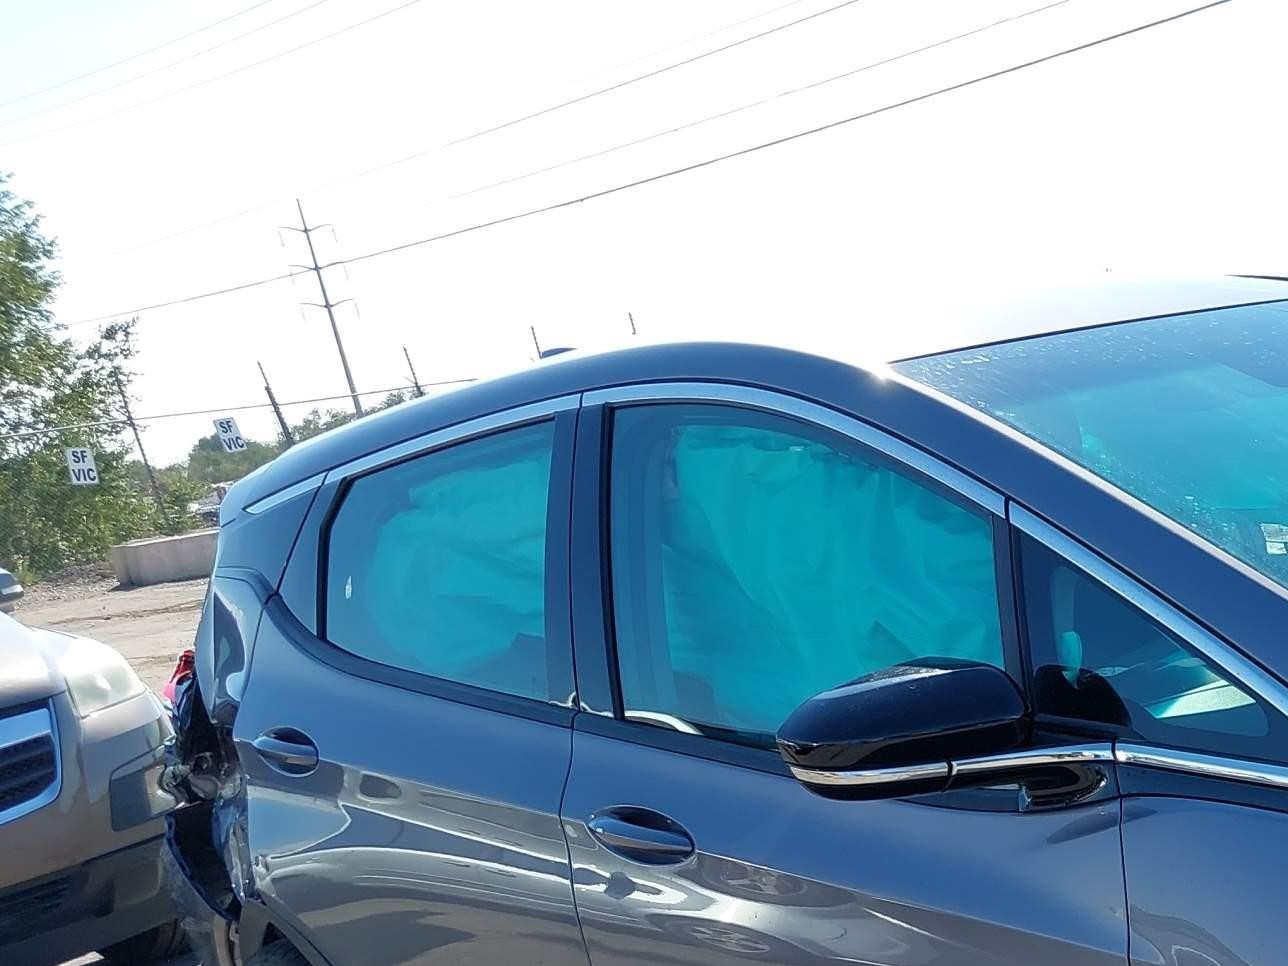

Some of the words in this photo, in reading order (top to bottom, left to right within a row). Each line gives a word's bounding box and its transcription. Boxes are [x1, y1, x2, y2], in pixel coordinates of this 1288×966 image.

[219, 420, 233, 434] SF
[222, 436, 245, 451] VIC
[71, 450, 88, 464] SF
[71, 468, 97, 482] VIC
